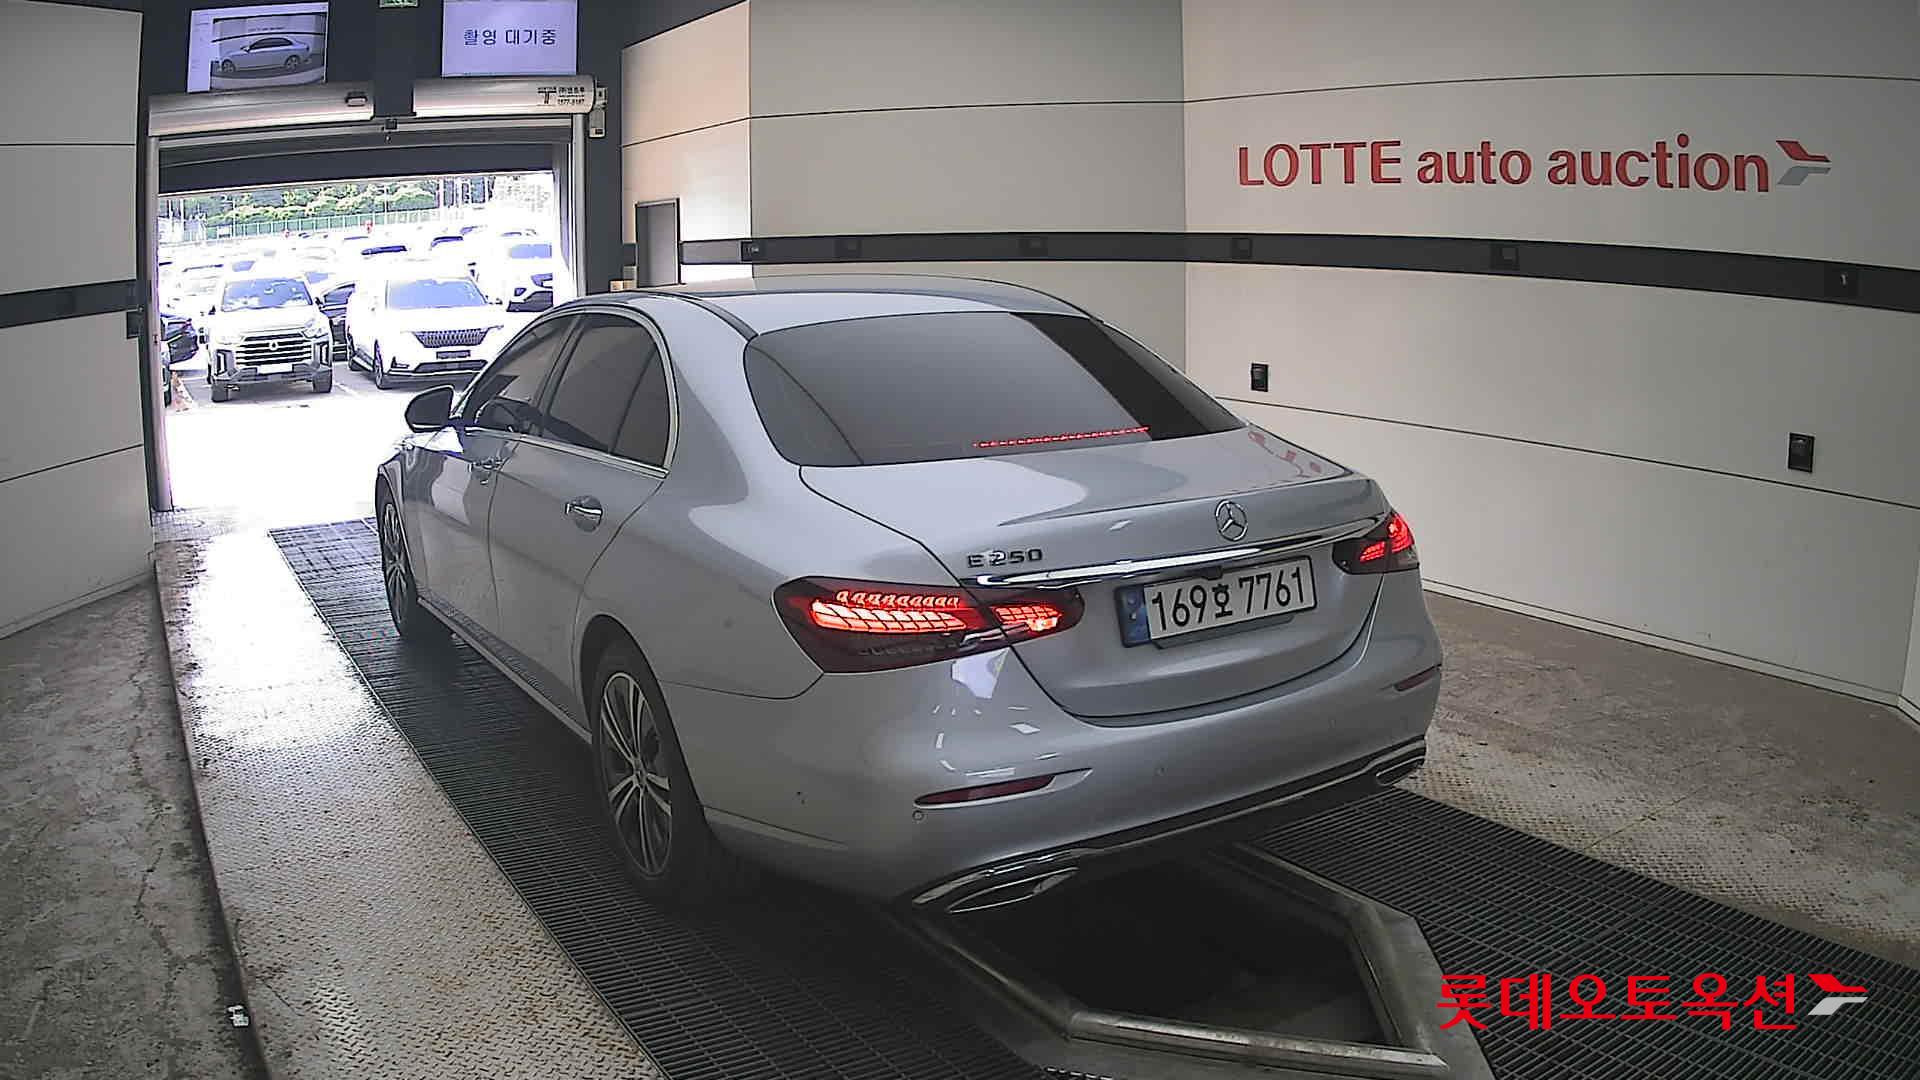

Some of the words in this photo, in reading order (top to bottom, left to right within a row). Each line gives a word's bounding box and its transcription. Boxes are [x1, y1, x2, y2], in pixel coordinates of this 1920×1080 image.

[464, 29, 497, 46] 촬영
[505, 29, 556, 46] 대기중
[1239, 140, 1401, 187] LOTTE
[1417, 141, 1532, 185] auto
[1548, 133, 1769, 192] auction
[967, 555, 984, 568] E
[990, 549, 1042, 566] 250
[1239, 567, 1304, 614] 7761
